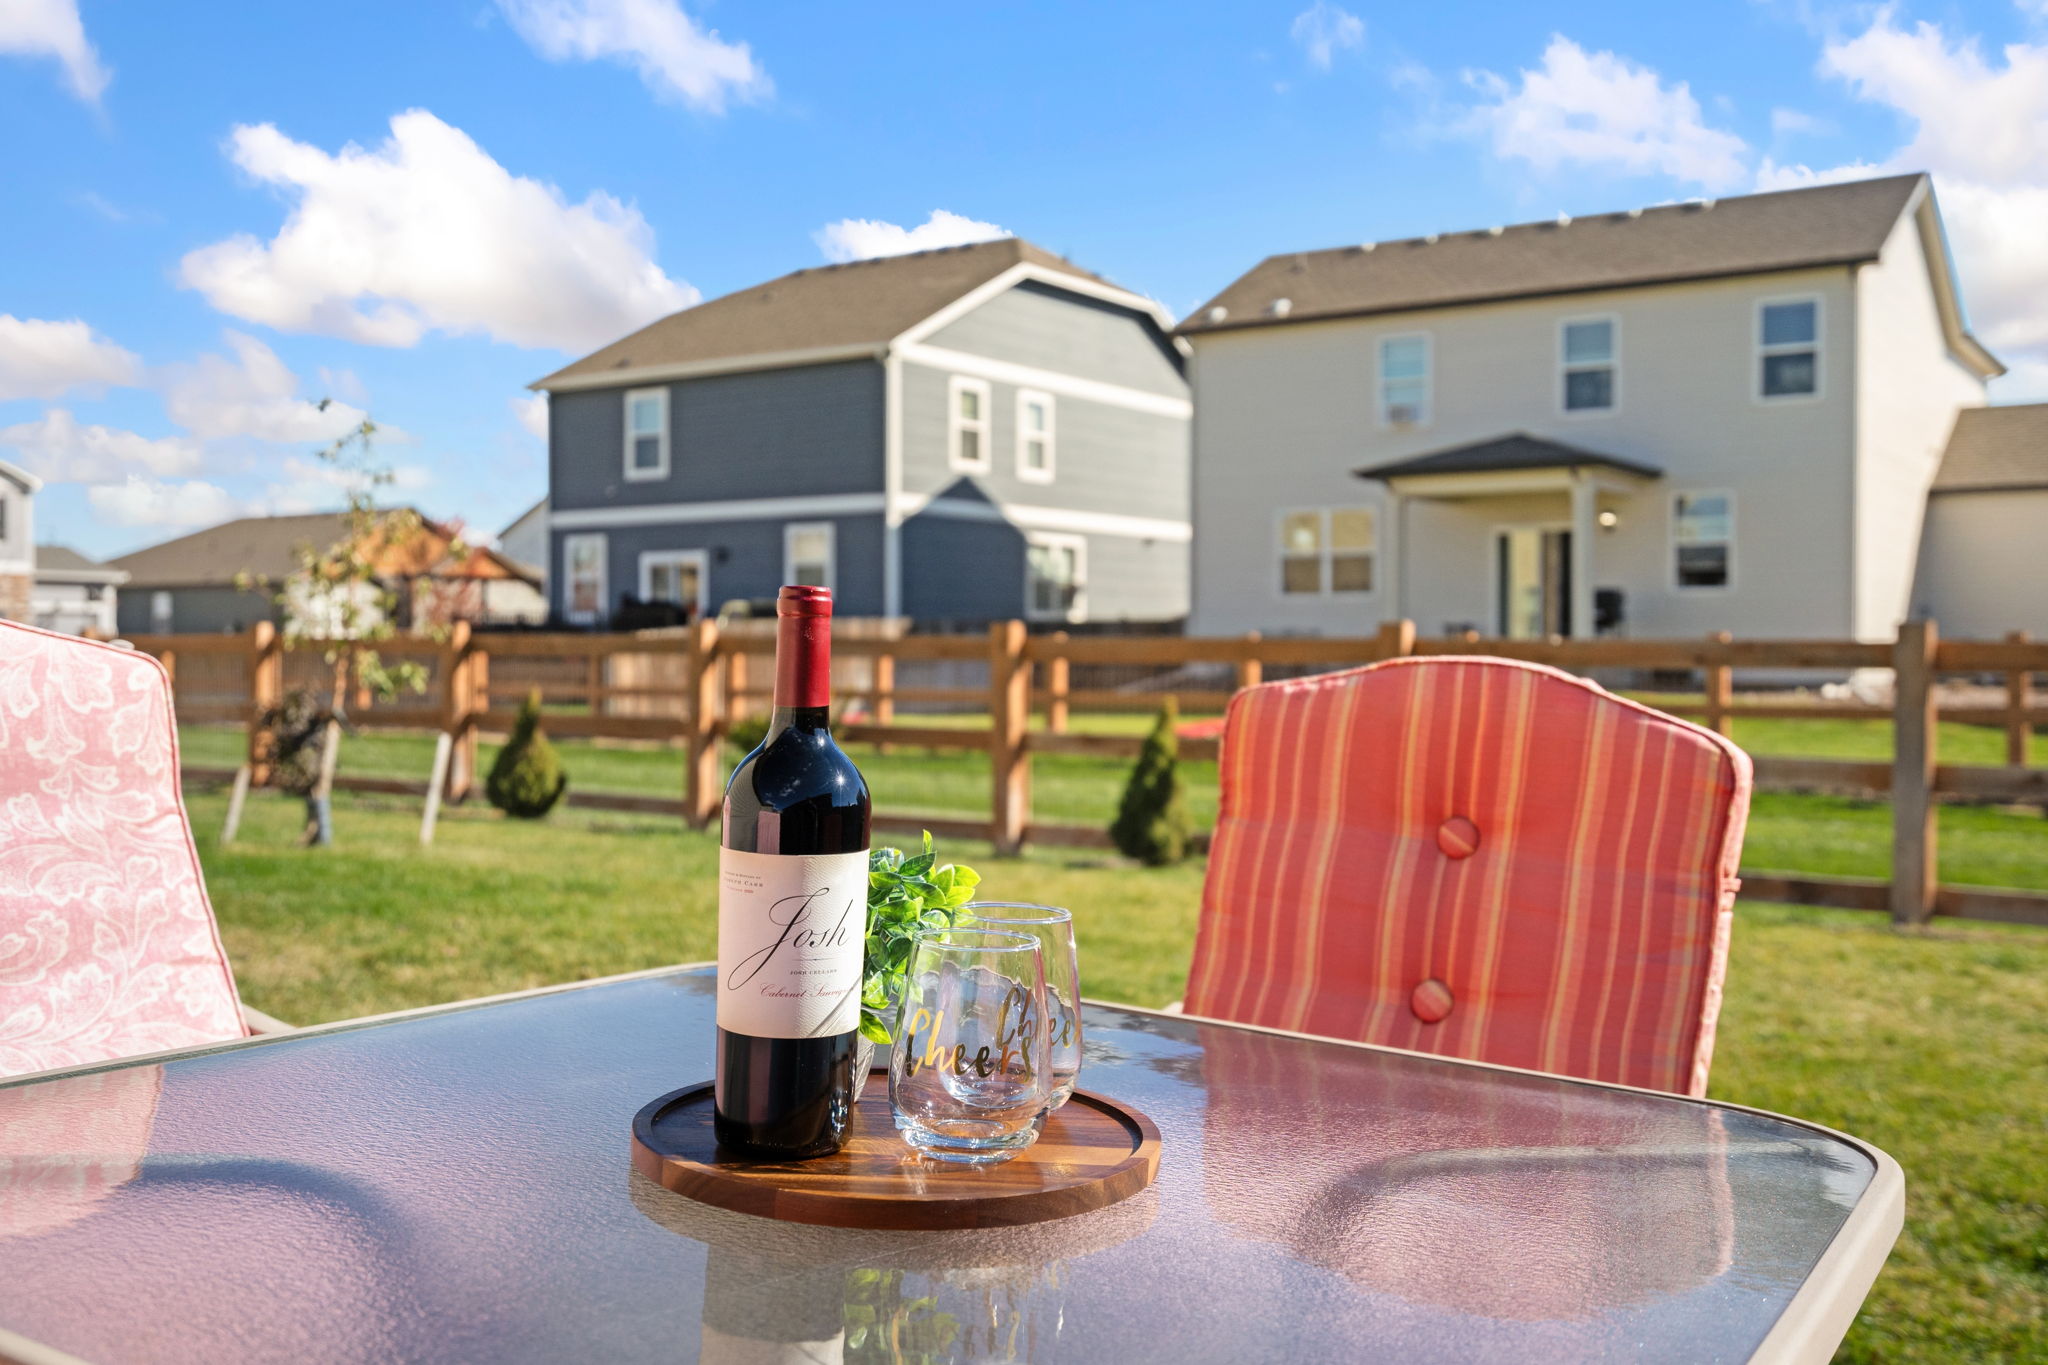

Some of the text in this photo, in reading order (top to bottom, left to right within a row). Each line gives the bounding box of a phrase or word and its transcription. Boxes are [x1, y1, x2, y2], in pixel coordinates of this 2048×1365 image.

[728, 887, 854, 991] Josh
[760, 983, 807, 998] Cabernet
[905, 1007, 1032, 1083] Cheers
